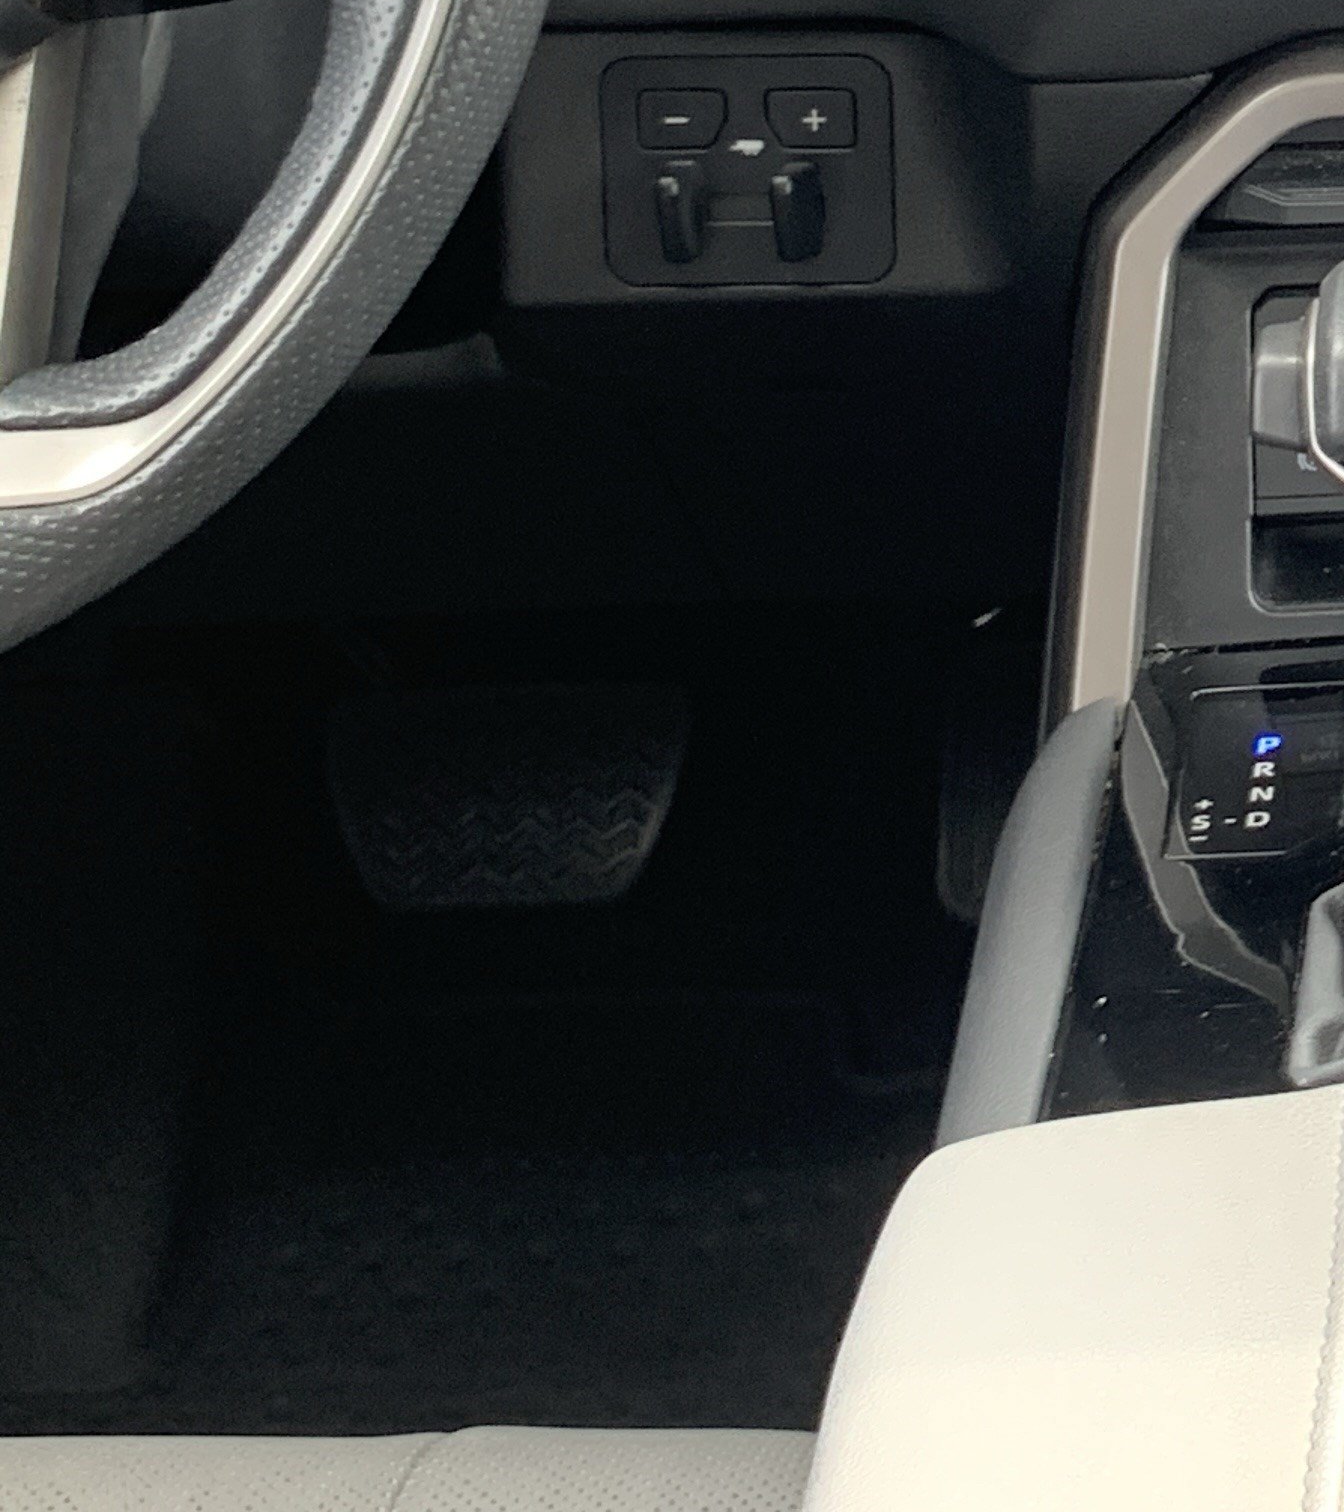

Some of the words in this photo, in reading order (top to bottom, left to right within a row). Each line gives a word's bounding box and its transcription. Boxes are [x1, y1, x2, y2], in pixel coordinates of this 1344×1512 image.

[1254, 735, 1282, 756] P
[1252, 761, 1276, 779] R
[1250, 785, 1275, 803] N
[1190, 814, 1211, 832] S
[1244, 810, 1271, 829] D
